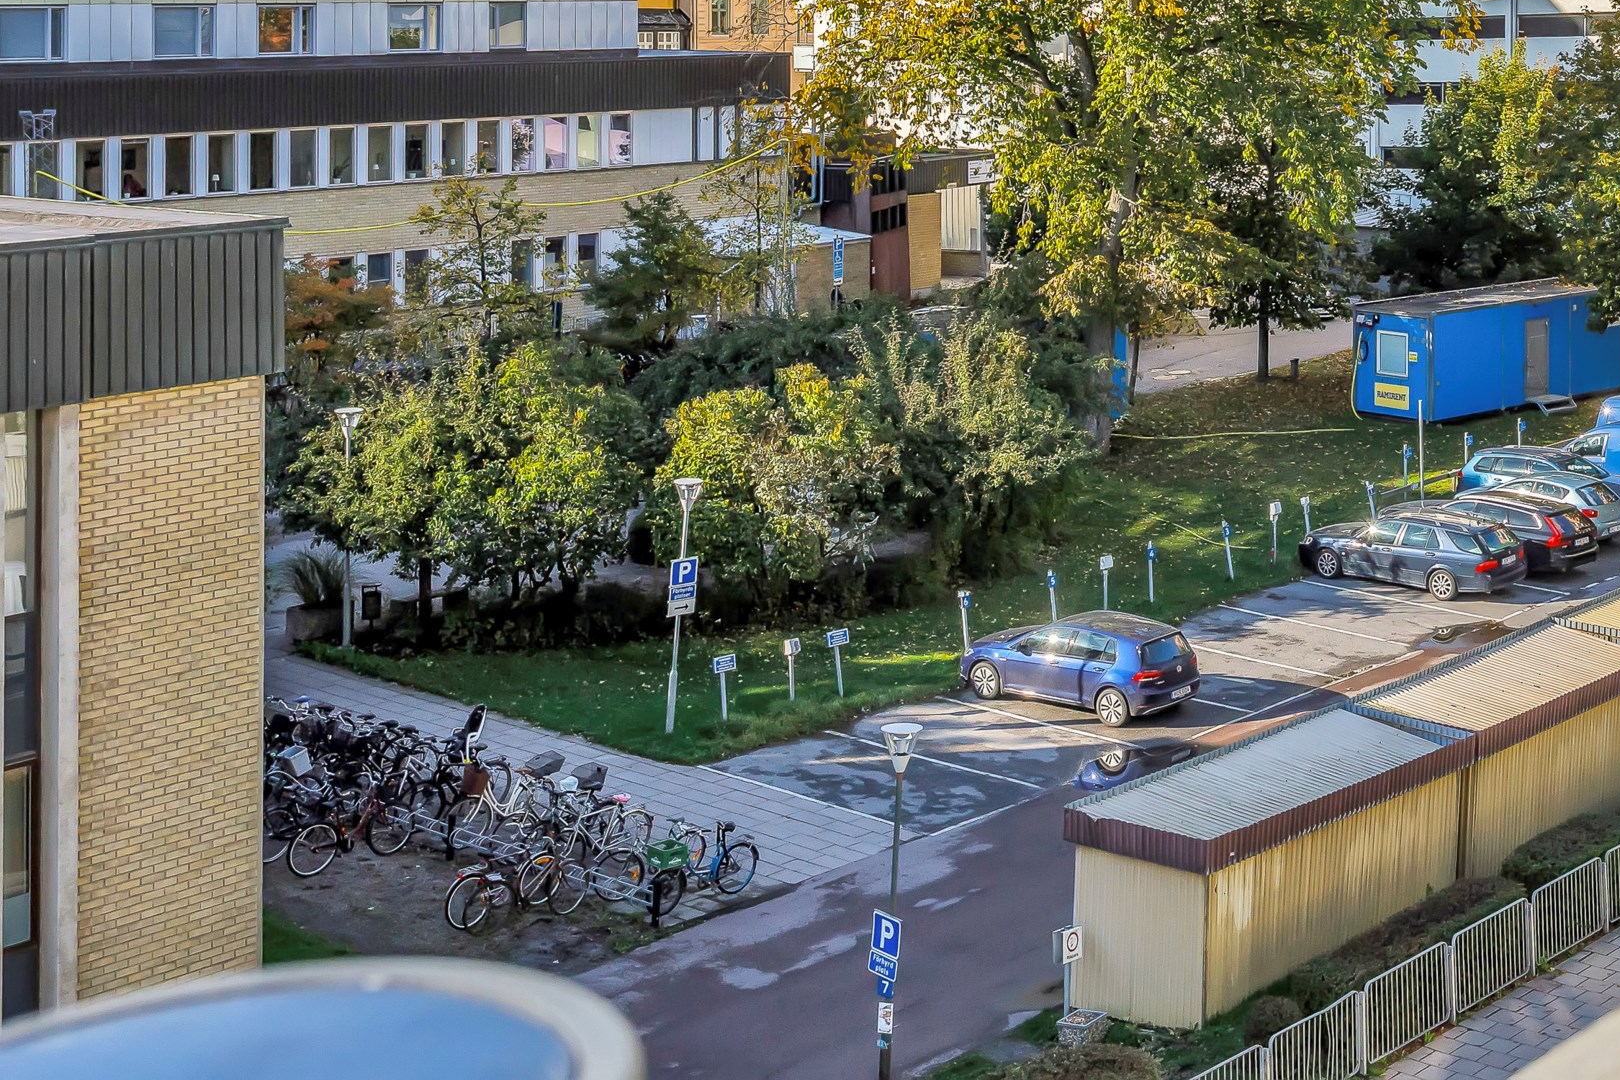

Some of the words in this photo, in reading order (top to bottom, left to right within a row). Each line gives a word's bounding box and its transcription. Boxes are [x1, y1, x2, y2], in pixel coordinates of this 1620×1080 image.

[1376, 390, 1407, 401] RAMIRENT
[678, 561, 692, 583] P
[963, 597, 969, 606] 6
[880, 918, 894, 949] P
[872, 953, 894, 969] Förhyrd
[881, 980, 889, 994] 7
